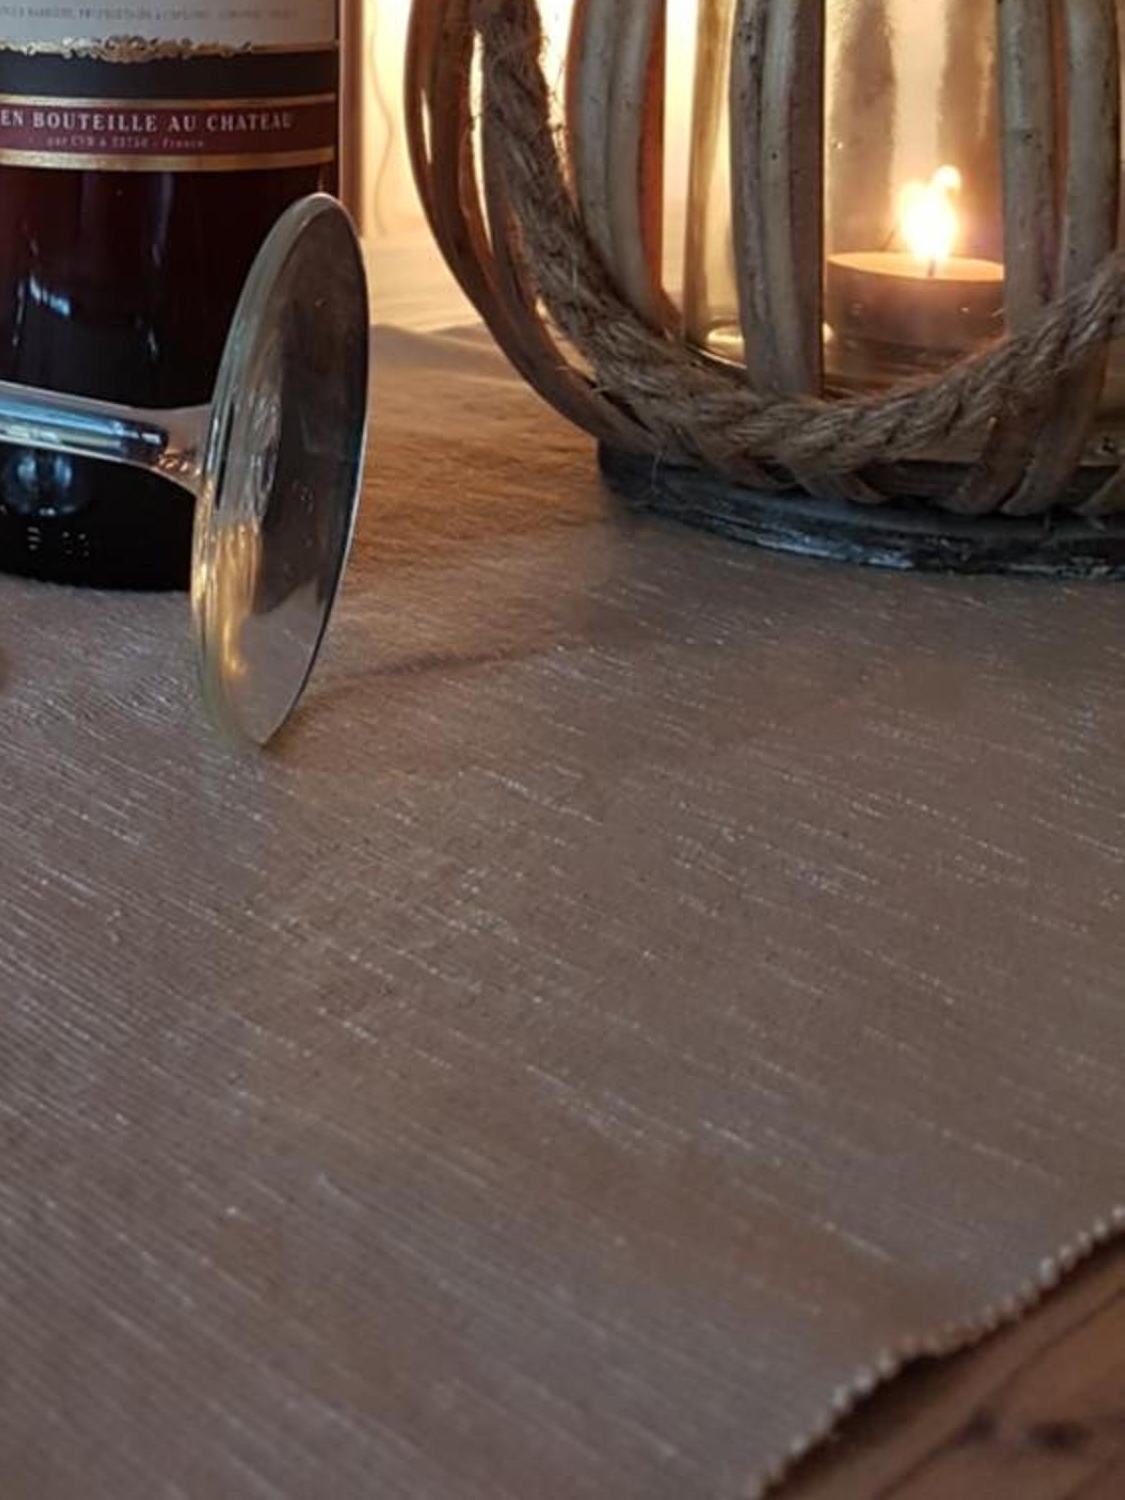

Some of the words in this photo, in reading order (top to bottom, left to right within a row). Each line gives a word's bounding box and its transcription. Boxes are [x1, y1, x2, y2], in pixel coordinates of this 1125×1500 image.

[0, 109, 24, 127] EN
[32, 111, 158, 133] BOUTEILLE
[168, 114, 196, 133] AU
[206, 112, 293, 133] CHATEAU
